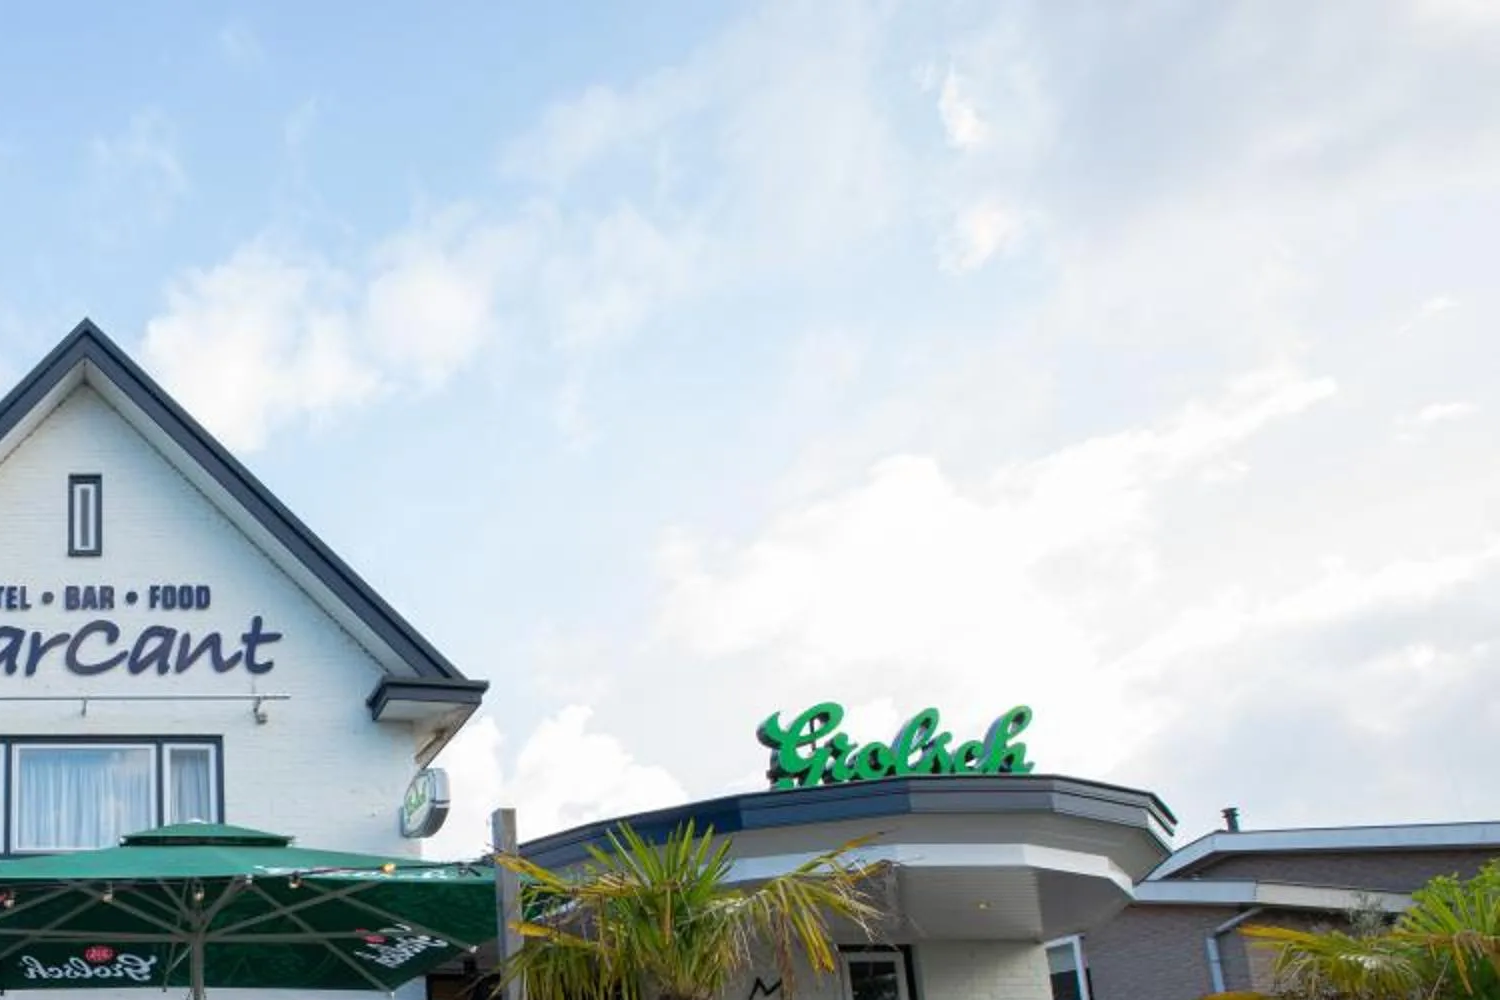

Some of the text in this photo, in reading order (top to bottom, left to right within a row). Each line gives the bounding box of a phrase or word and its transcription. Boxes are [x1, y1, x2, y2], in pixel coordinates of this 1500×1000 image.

[65, 585, 116, 611] BAR
[148, 584, 211, 611] FOOD
[756, 701, 1035, 789] Grolsch
